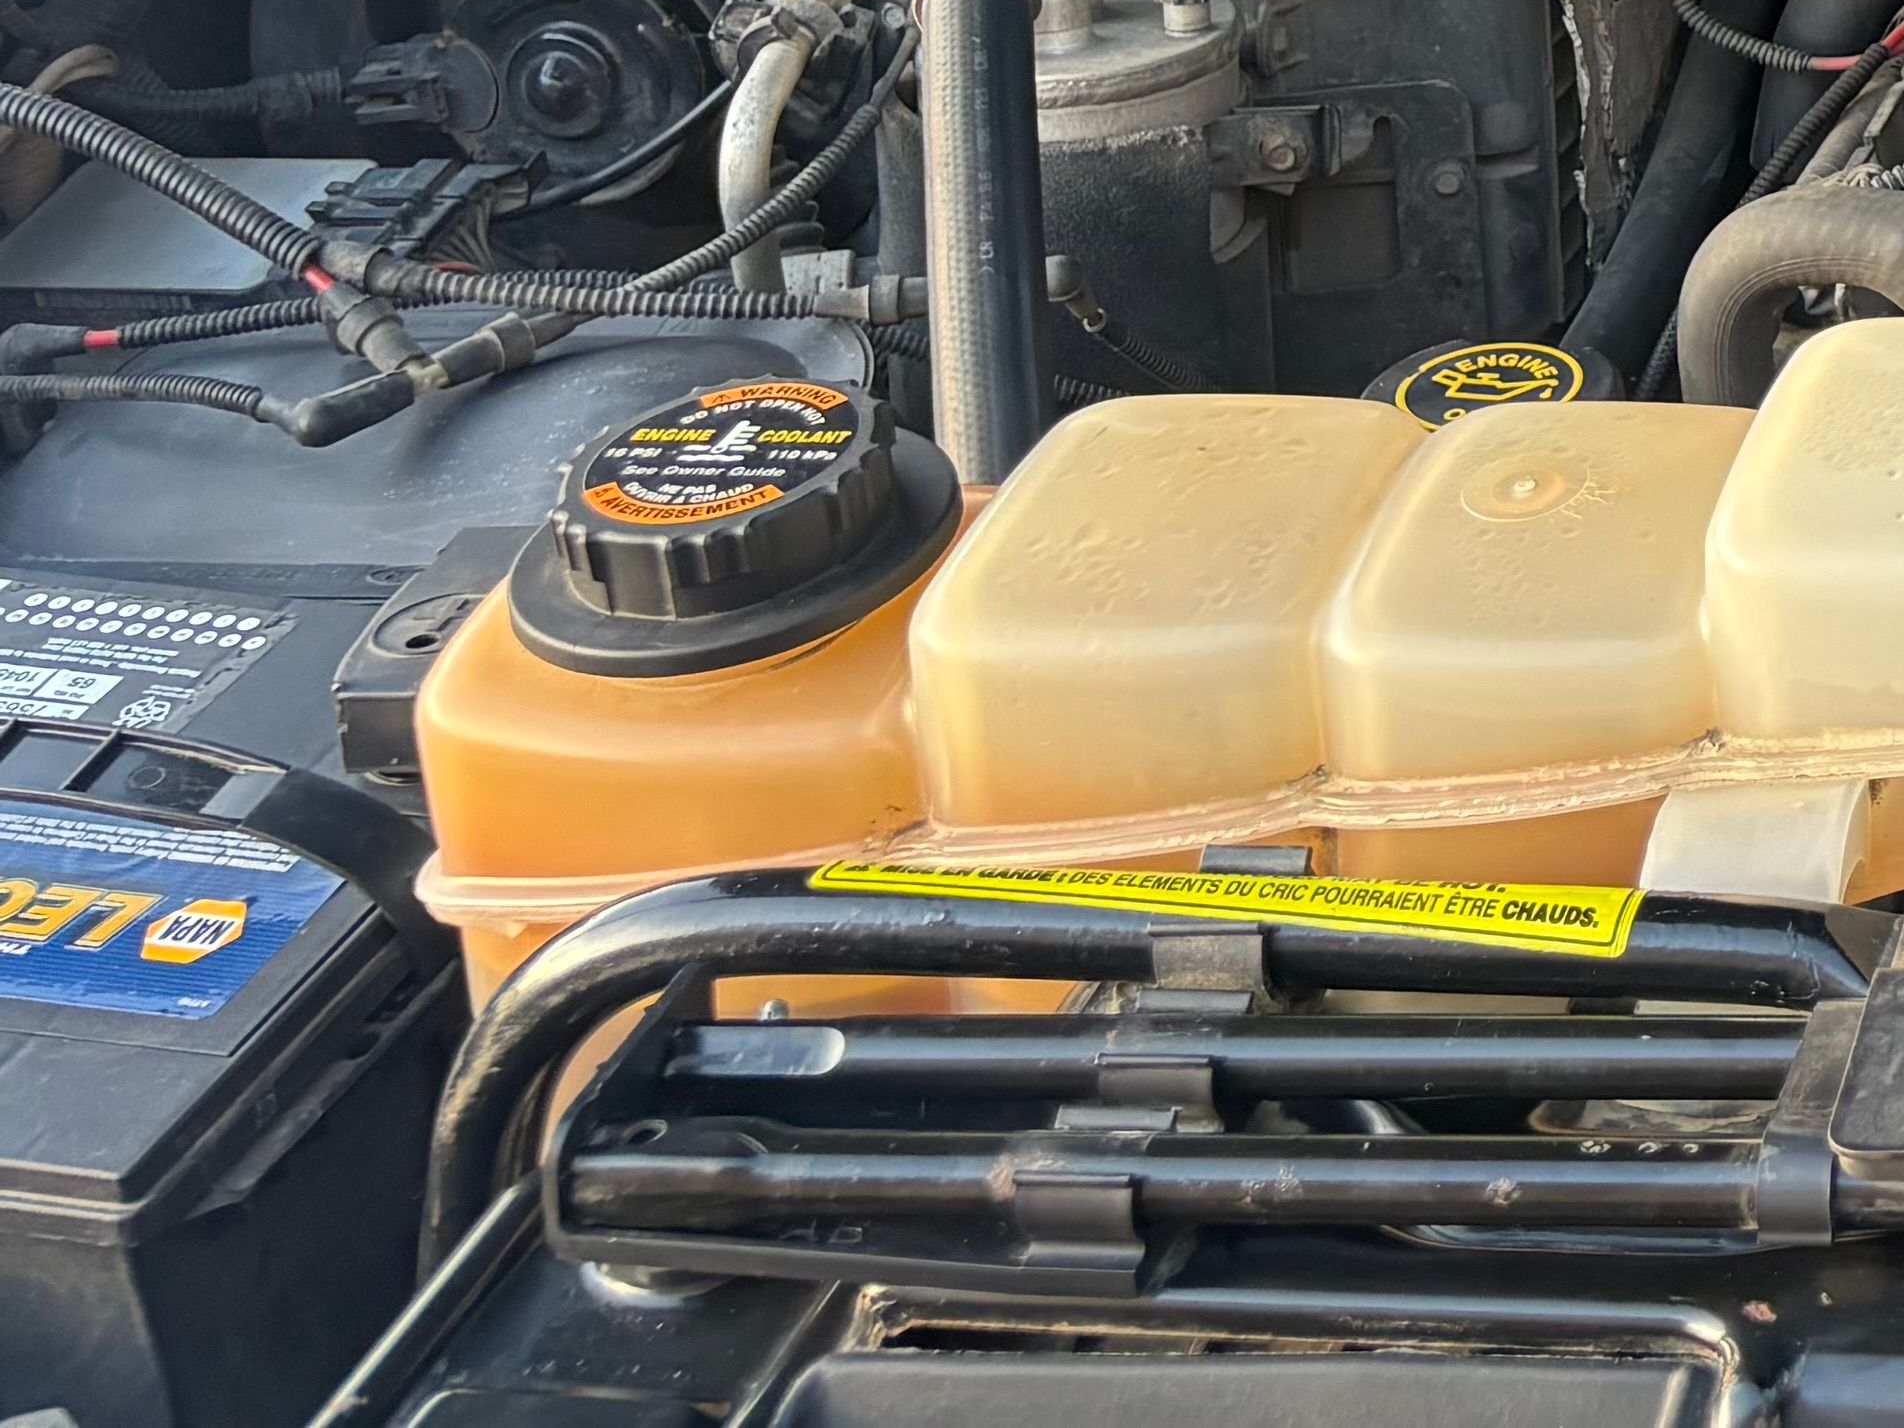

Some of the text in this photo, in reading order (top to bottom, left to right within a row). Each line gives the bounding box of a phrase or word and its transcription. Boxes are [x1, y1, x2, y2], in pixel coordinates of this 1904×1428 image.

[1454, 353, 1559, 380] ENGINE
[739, 386, 837, 405] WARNING
[680, 410, 708, 425] DO
[714, 400, 756, 415] NOT
[759, 400, 803, 417] OPEN
[630, 428, 852, 445] ENGINE COOLANT
[604, 447, 662, 458] 16 PSI
[766, 450, 800, 461] 110
[621, 465, 788, 478] See Owner Guide
[690, 483, 755, 505] CHAUD
[603, 490, 769, 519] AVERTISSEMENT
[66, 676, 97, 689] 65
[1071, 870, 1105, 886] DES
[1225, 880, 1255, 898] DU
[1257, 881, 1307, 901] CRIC
[1310, 886, 1443, 915] POURRAIENT
[1444, 890, 1497, 919] ÊTRE
[1501, 899, 1600, 929] CHAUDS.
[158, 915, 236, 945] NAPA
